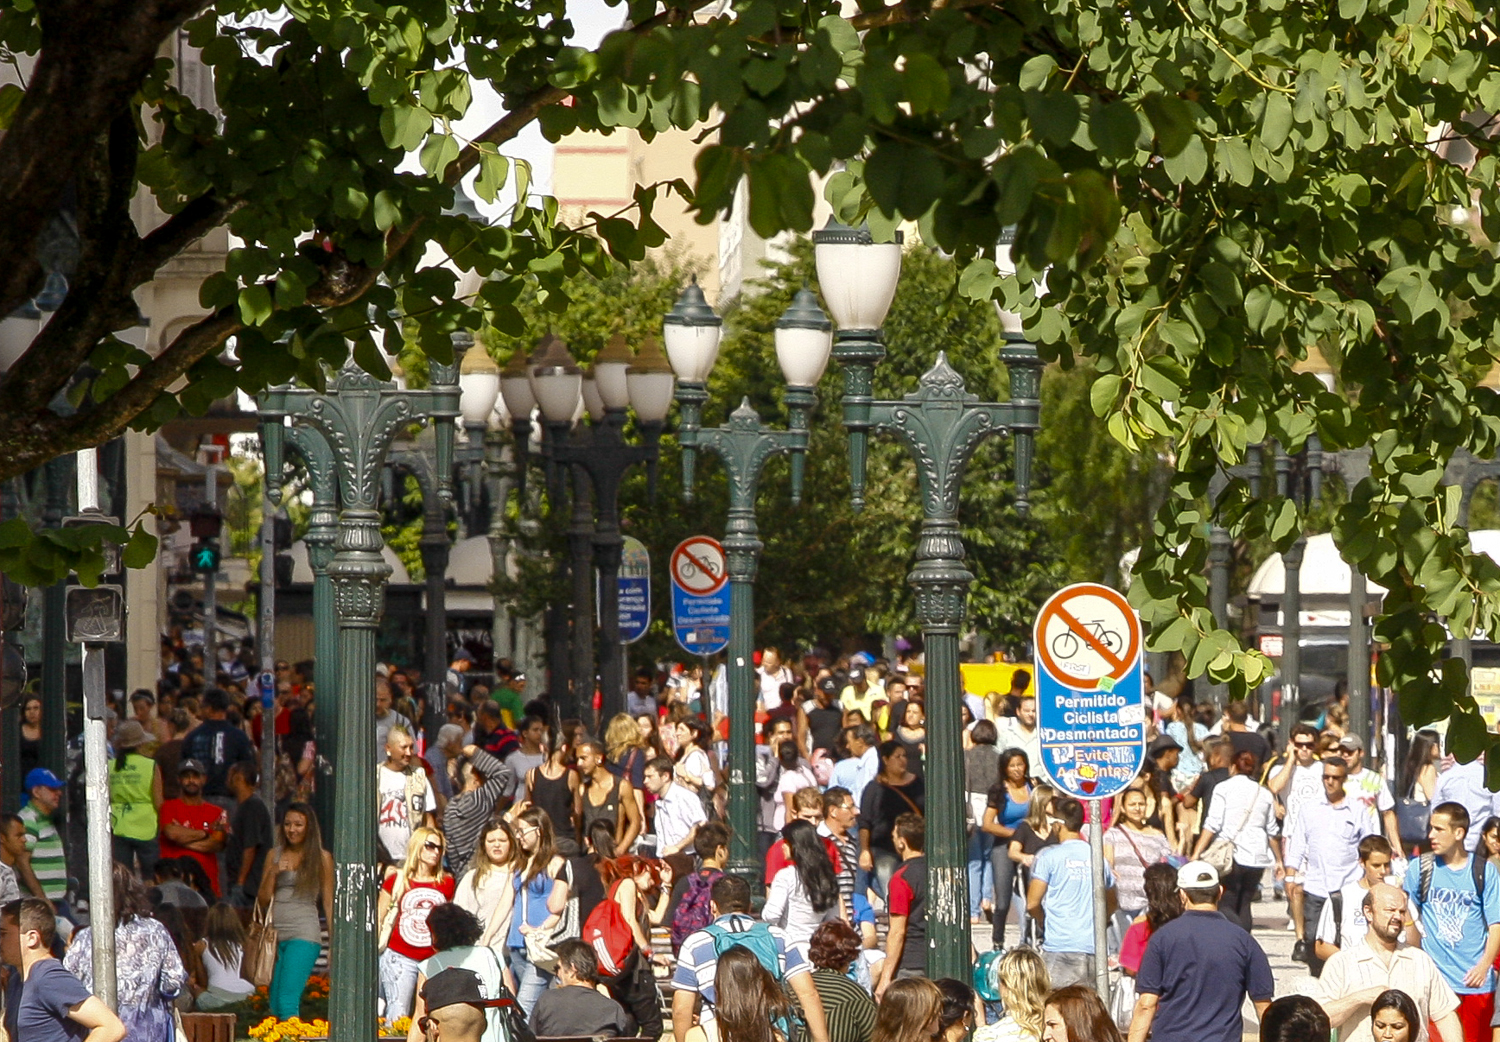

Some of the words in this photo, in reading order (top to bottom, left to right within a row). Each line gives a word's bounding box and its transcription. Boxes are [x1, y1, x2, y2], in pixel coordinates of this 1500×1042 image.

[1055, 693, 1126, 709] Permitido
[1063, 711, 1119, 725] Ciclista
[1046, 726, 1139, 742] Desmontado
[1074, 749, 1110, 763] Evite
